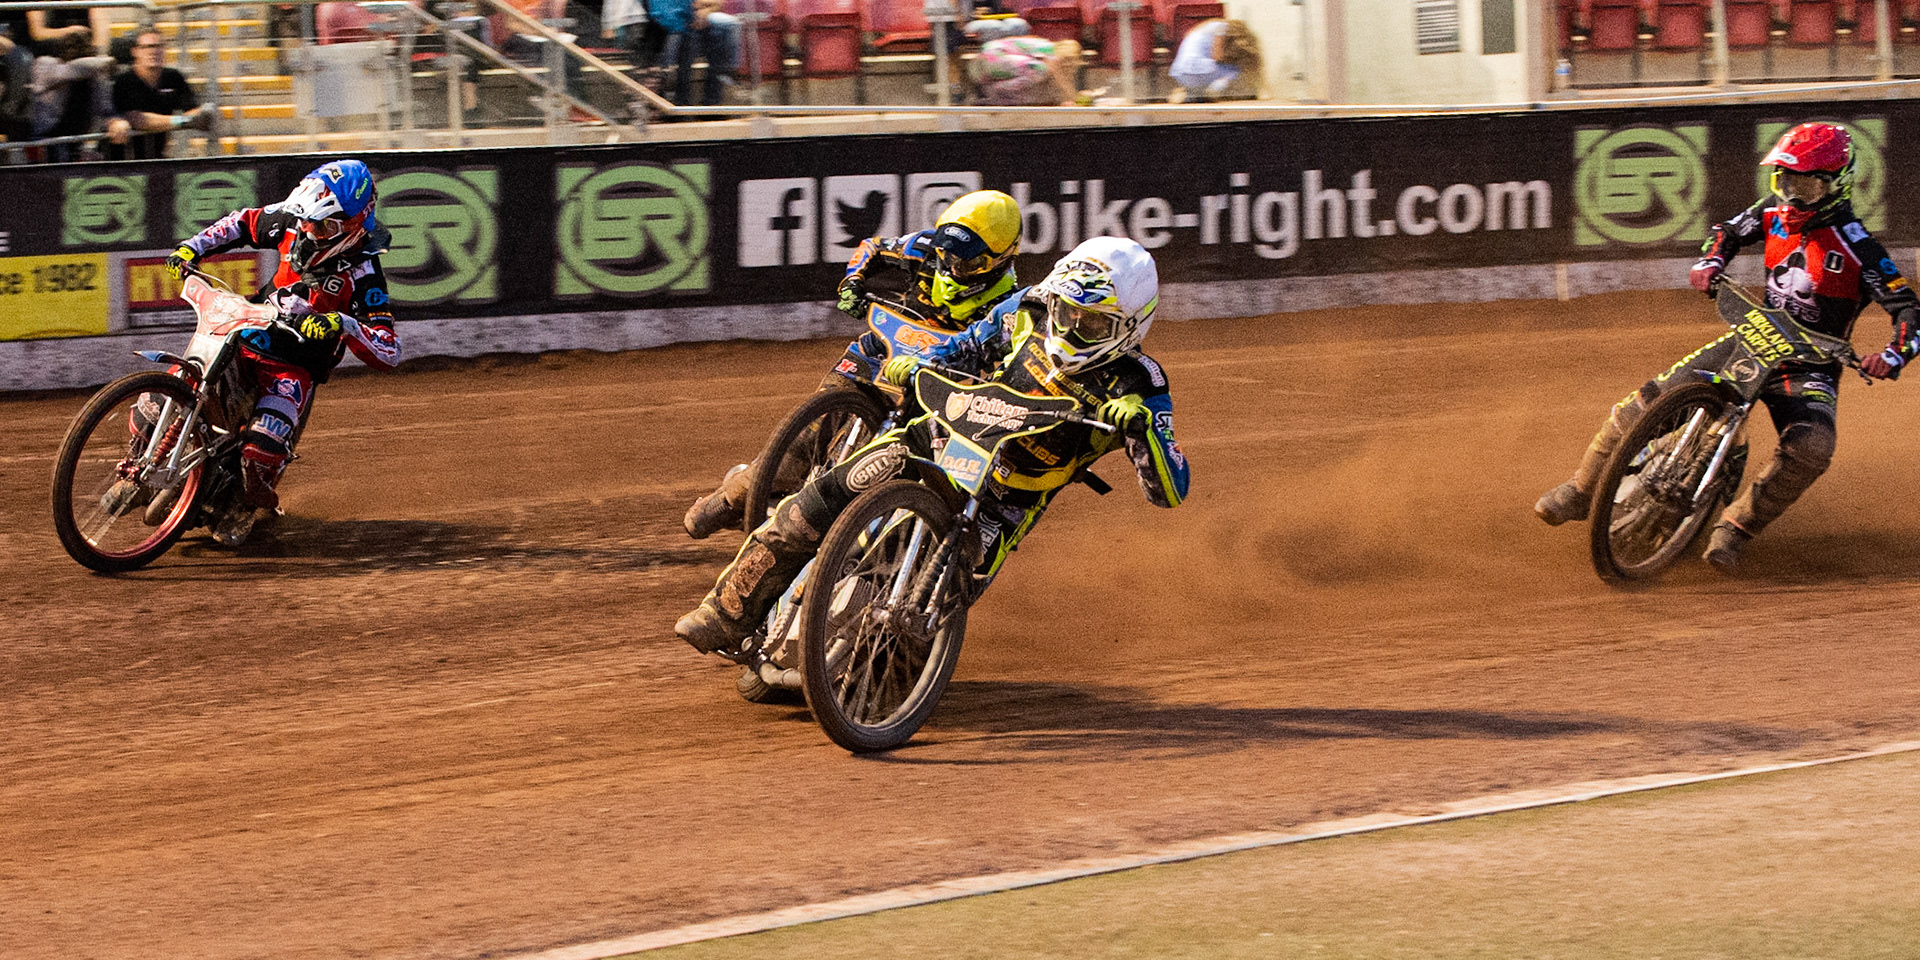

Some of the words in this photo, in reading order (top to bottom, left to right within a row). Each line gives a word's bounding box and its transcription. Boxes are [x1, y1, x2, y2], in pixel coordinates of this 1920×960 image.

[32, 262, 97, 293] 1982
[1744, 309, 1794, 355] KIRKLAND
[1055, 372, 1103, 406] WEBSTER
[970, 396, 1029, 419] Chiltern
[1016, 435, 1060, 466] CUBS
